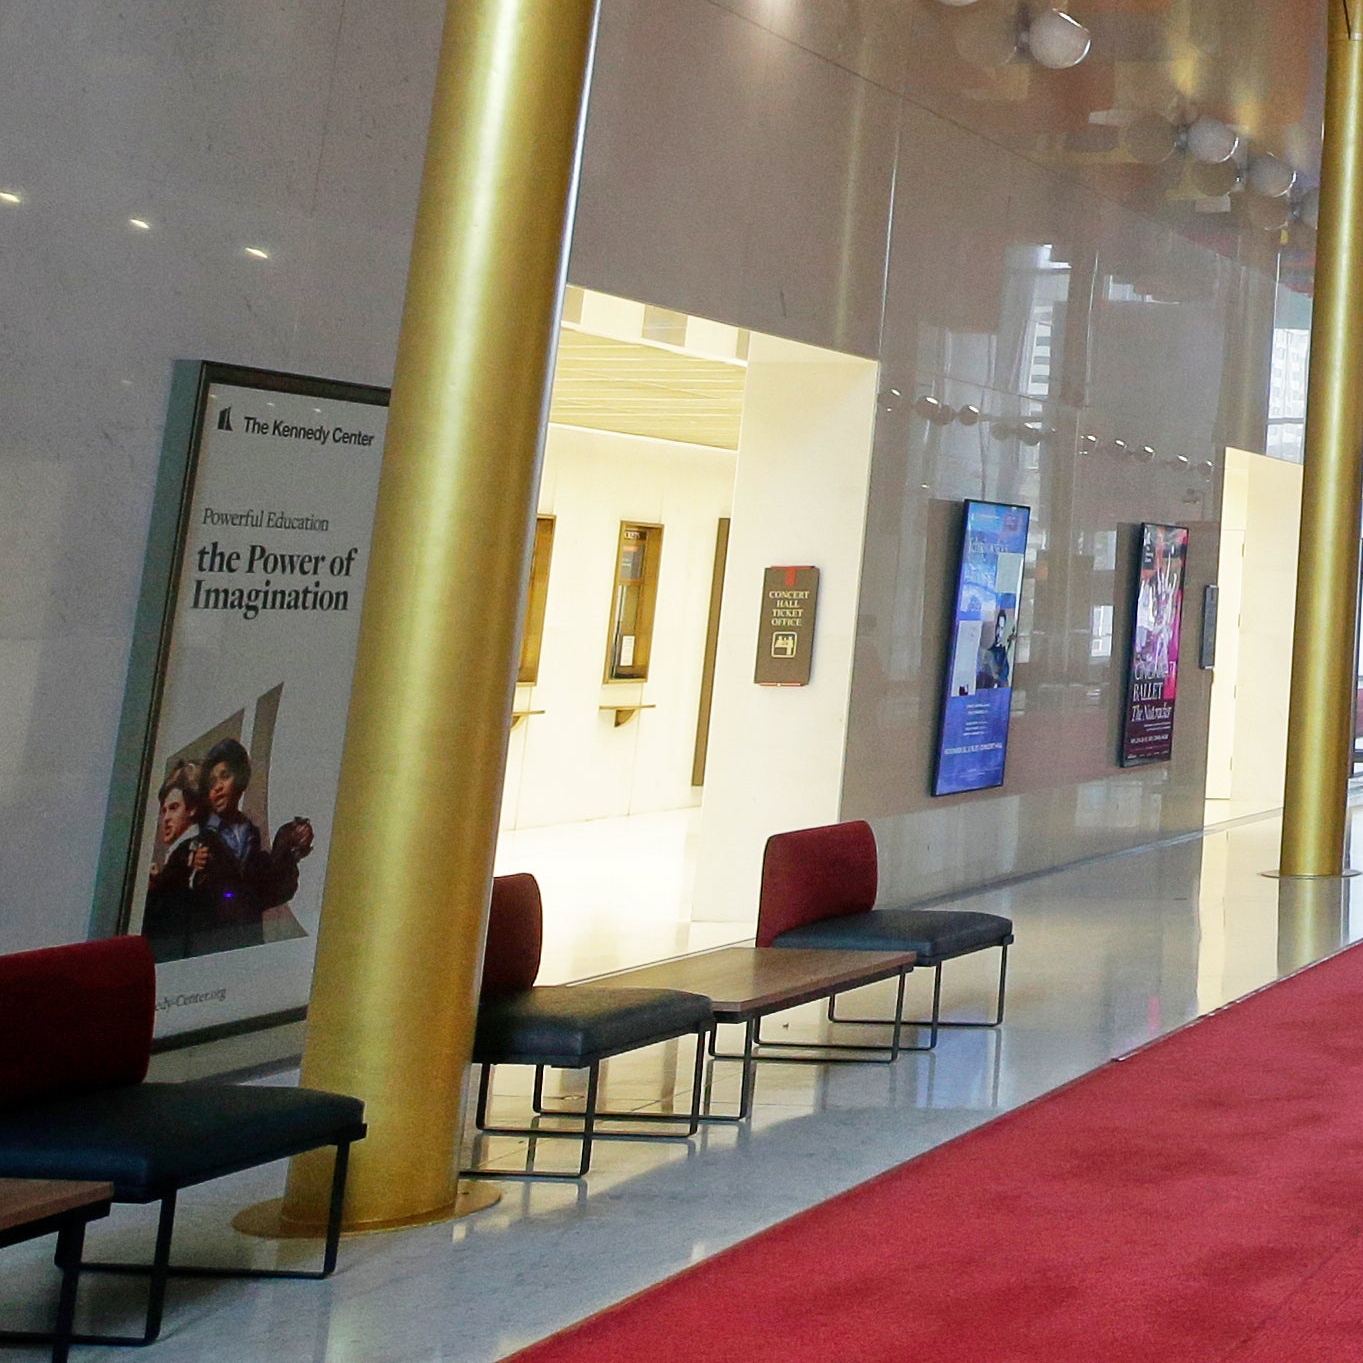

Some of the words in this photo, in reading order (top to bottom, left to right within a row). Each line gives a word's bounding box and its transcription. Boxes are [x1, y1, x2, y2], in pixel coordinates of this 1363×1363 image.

[244, 416, 268, 435] The
[272, 420, 330, 445] Kennedy
[332, 427, 375, 446] Center
[202, 507, 264, 528] Powerful
[266, 510, 329, 532] Education
[197, 541, 241, 573] the
[245, 544, 326, 575] Power
[329, 547, 358, 577] of
[190, 579, 349, 620] Imagination
[769, 590, 810, 599] CONCERT
[776, 599, 800, 608] HALL
[771, 618, 802, 626] OFFICE
[772, 609, 804, 617] TICKET
[1133, 682, 1163, 702] BALLET
